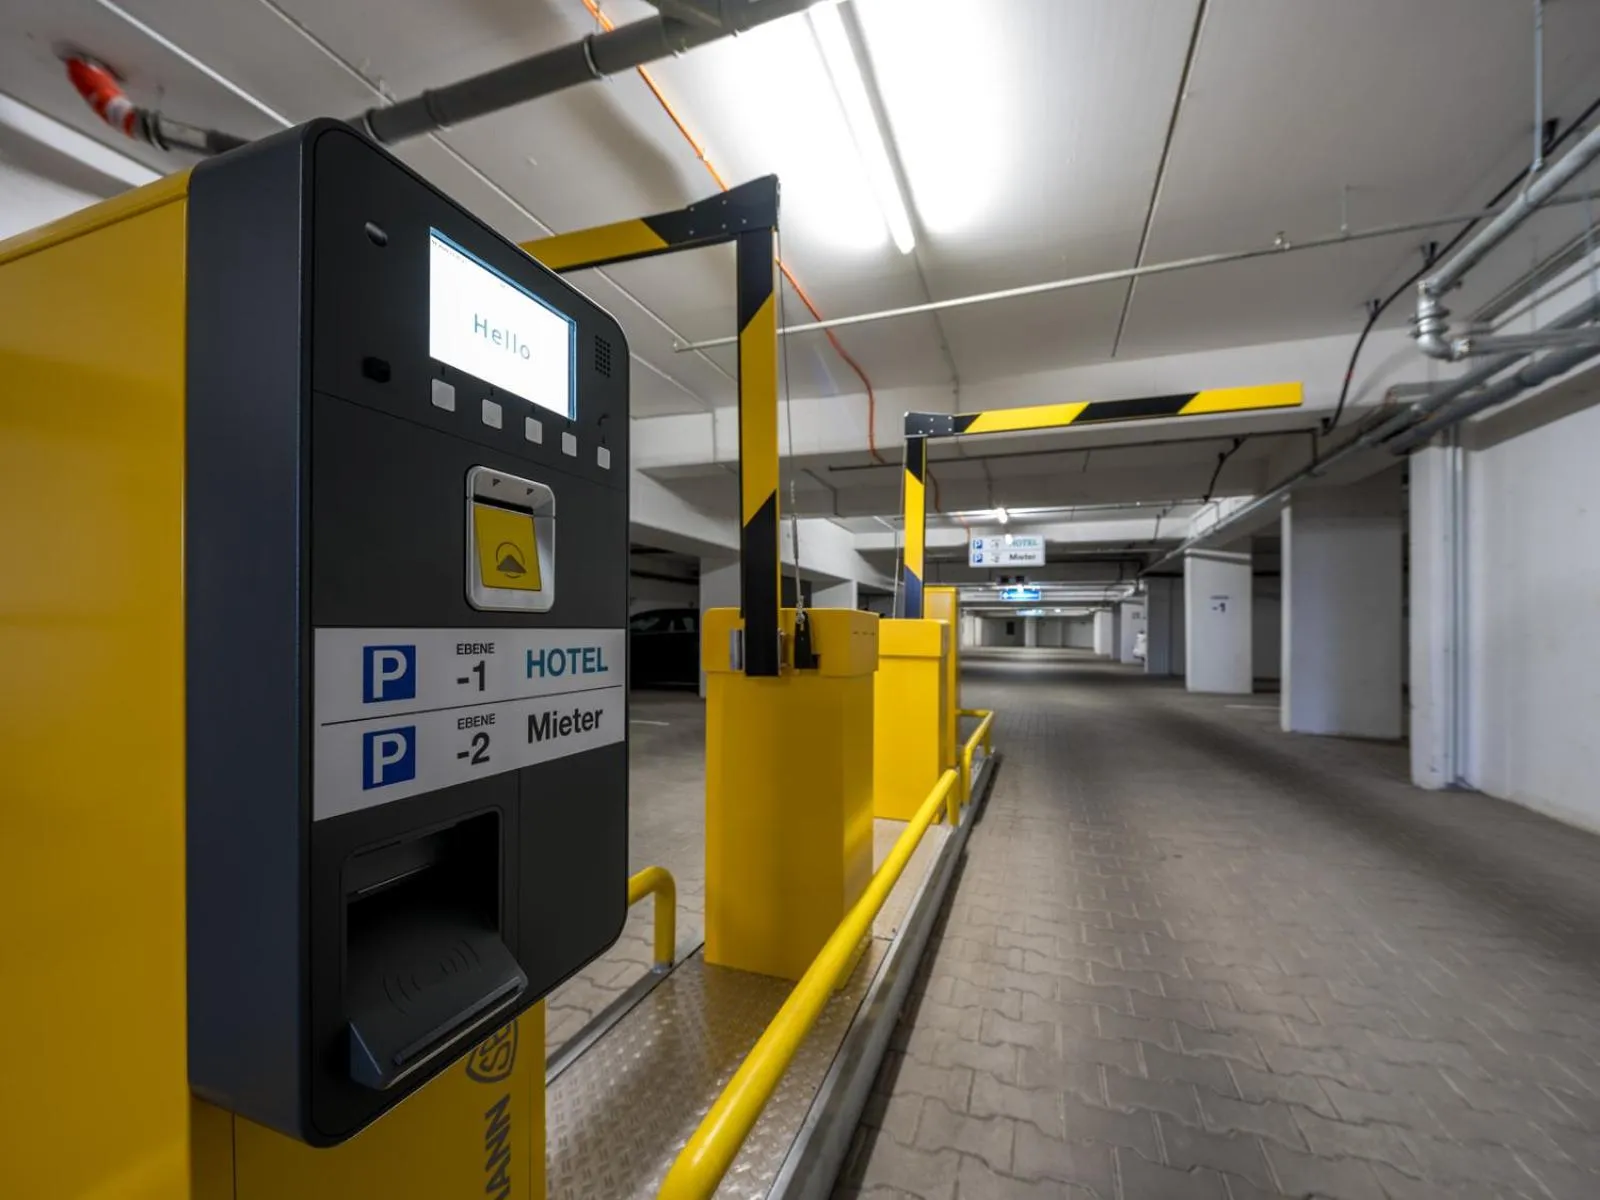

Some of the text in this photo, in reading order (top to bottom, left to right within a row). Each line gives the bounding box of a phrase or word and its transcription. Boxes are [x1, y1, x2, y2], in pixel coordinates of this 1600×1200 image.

[474, 313, 531, 360] Hello
[456, 642, 496, 655] EBENE
[372, 647, 608, 699] P -1 HOTEL
[457, 713, 496, 730] EBENE
[372, 708, 604, 784] P -2 Mieter
